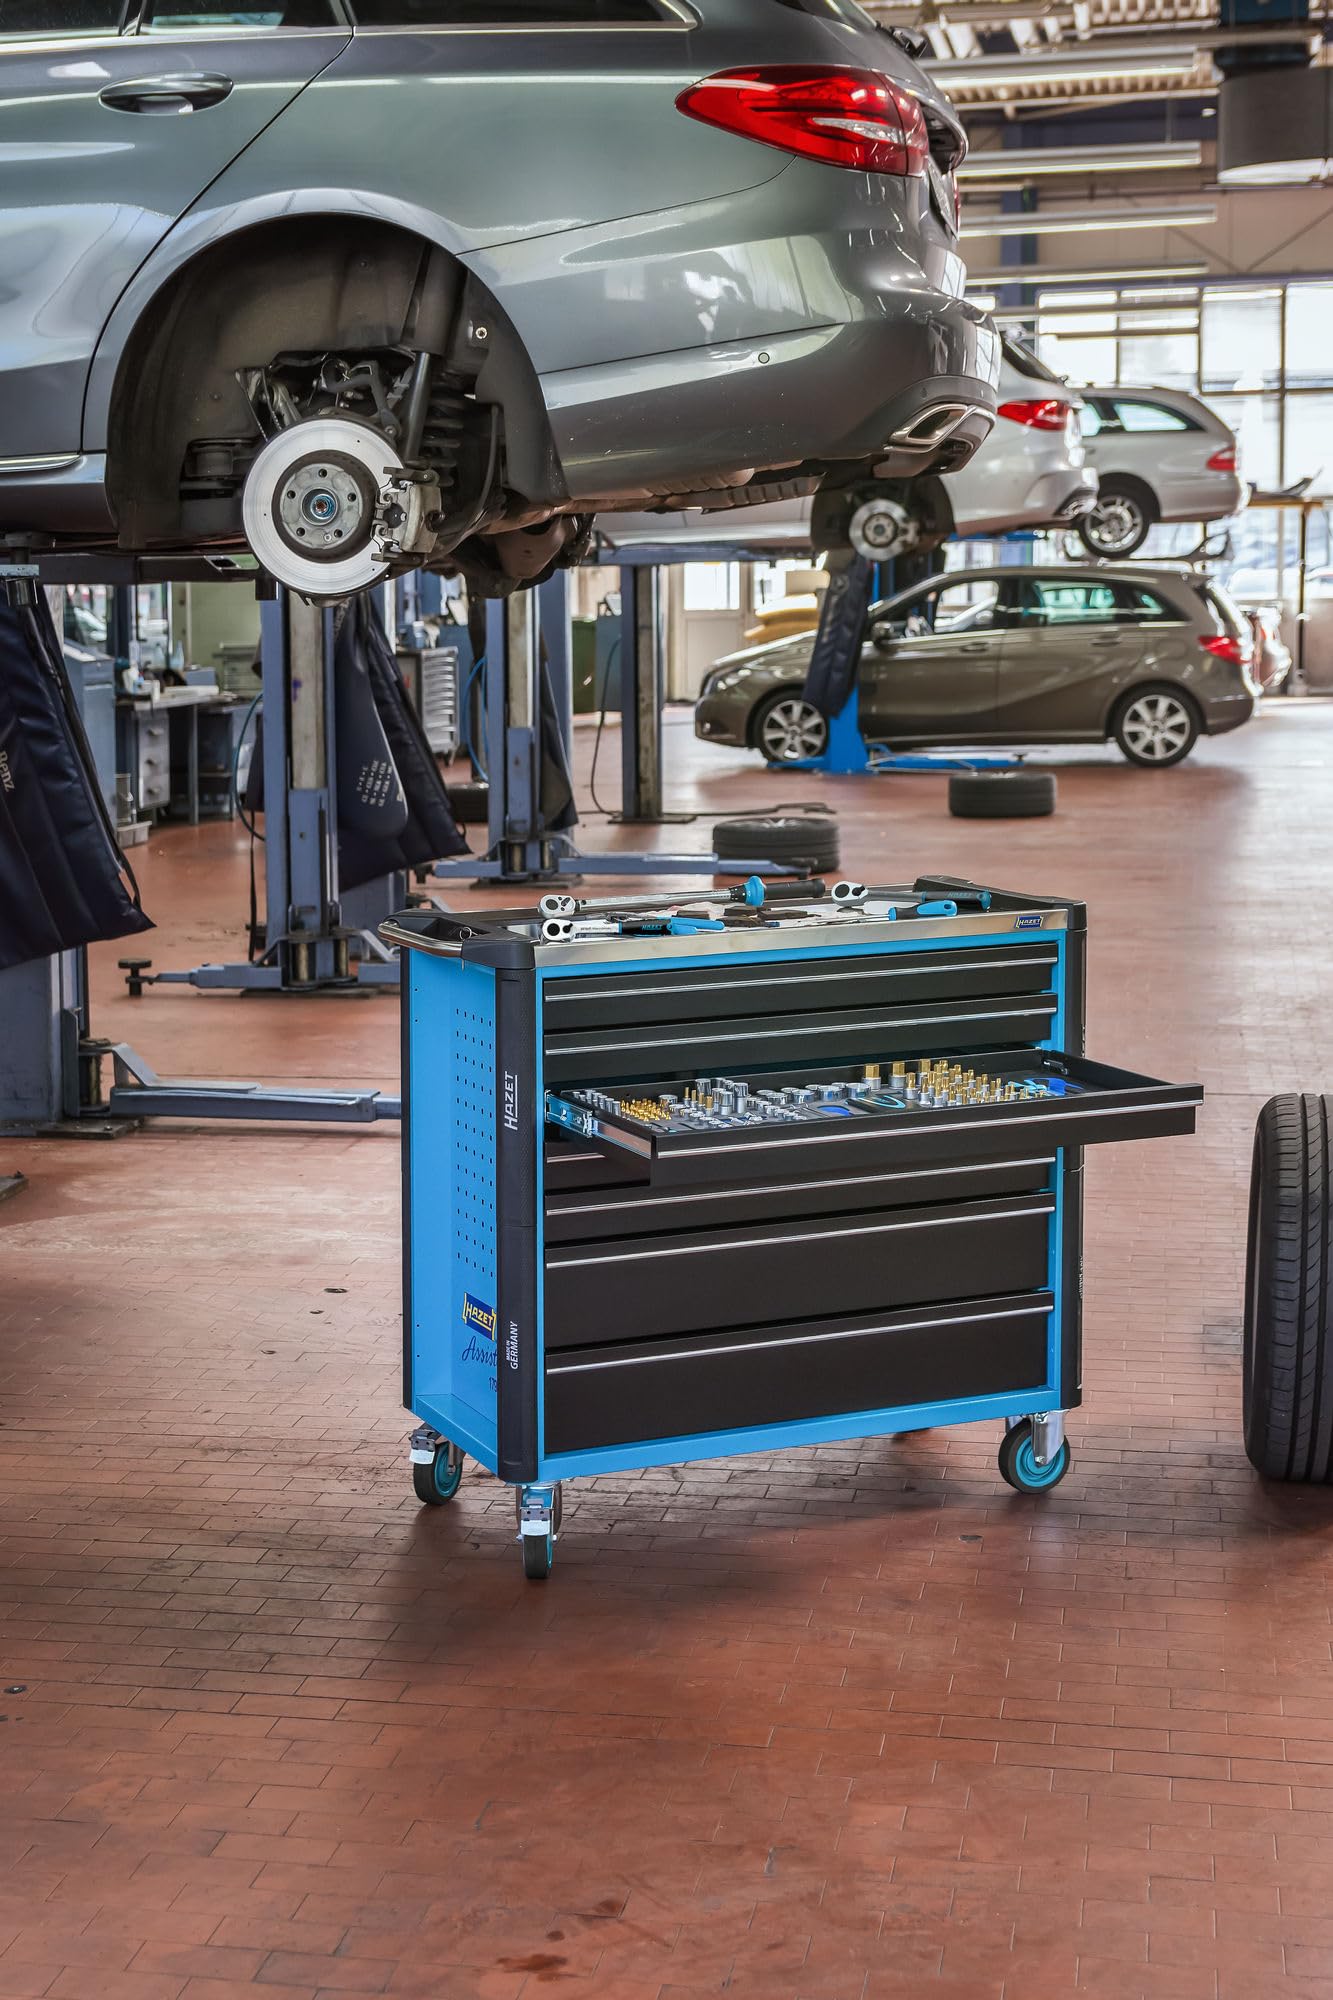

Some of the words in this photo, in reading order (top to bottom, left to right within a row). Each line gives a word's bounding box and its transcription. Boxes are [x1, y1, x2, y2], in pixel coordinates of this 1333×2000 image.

[1018, 918, 1041, 926] HAZET
[504, 1071, 518, 1131] HAZET
[466, 1301, 494, 1328] HAZET
[510, 1320, 519, 1370] GERMANY
